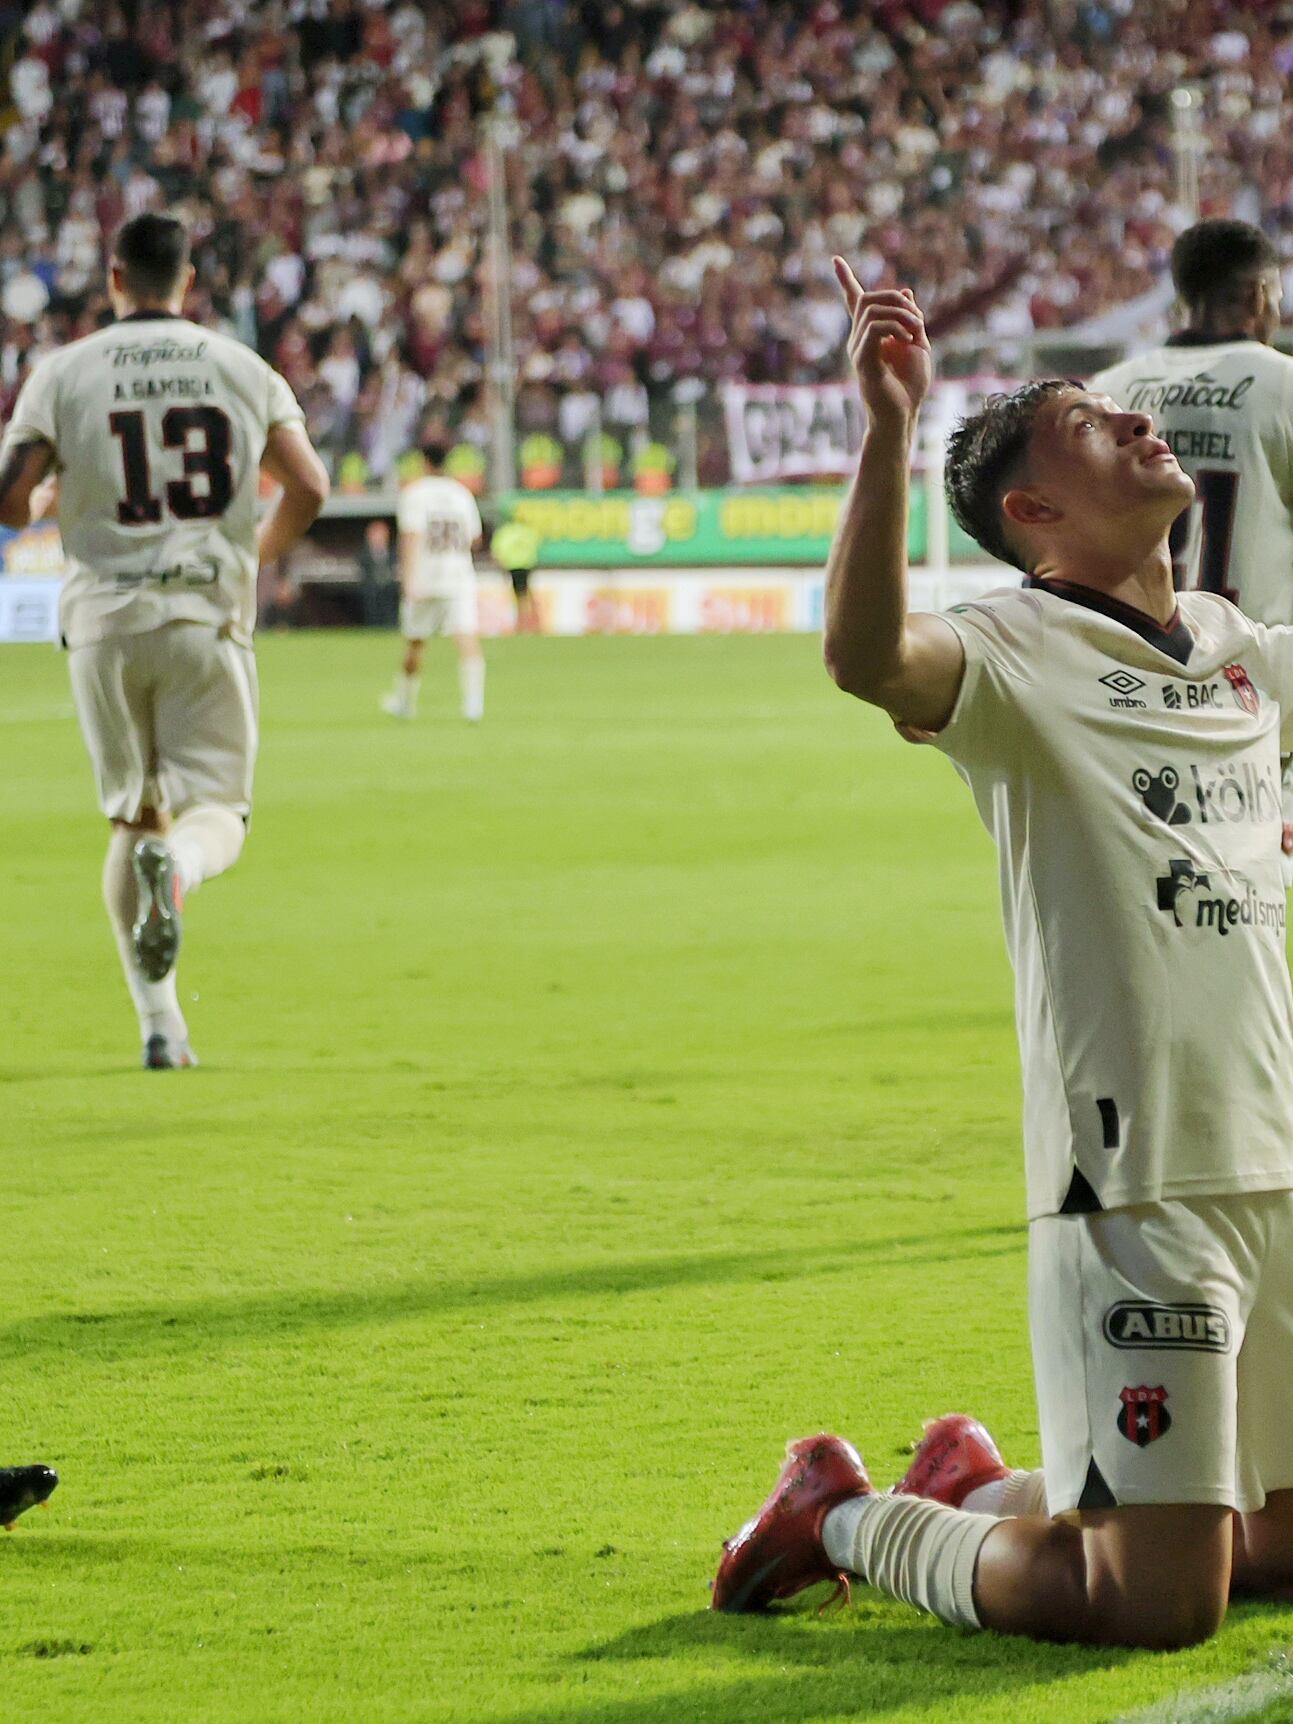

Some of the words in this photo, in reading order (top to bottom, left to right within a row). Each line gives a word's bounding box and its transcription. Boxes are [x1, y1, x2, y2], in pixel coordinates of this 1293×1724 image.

[1126, 372, 1256, 414] Tropical
[109, 406, 234, 526] 13
[1109, 696, 1147, 709] umbro
[1186, 684, 1223, 709] BAC
[1121, 1311, 1226, 1344] ABUS
